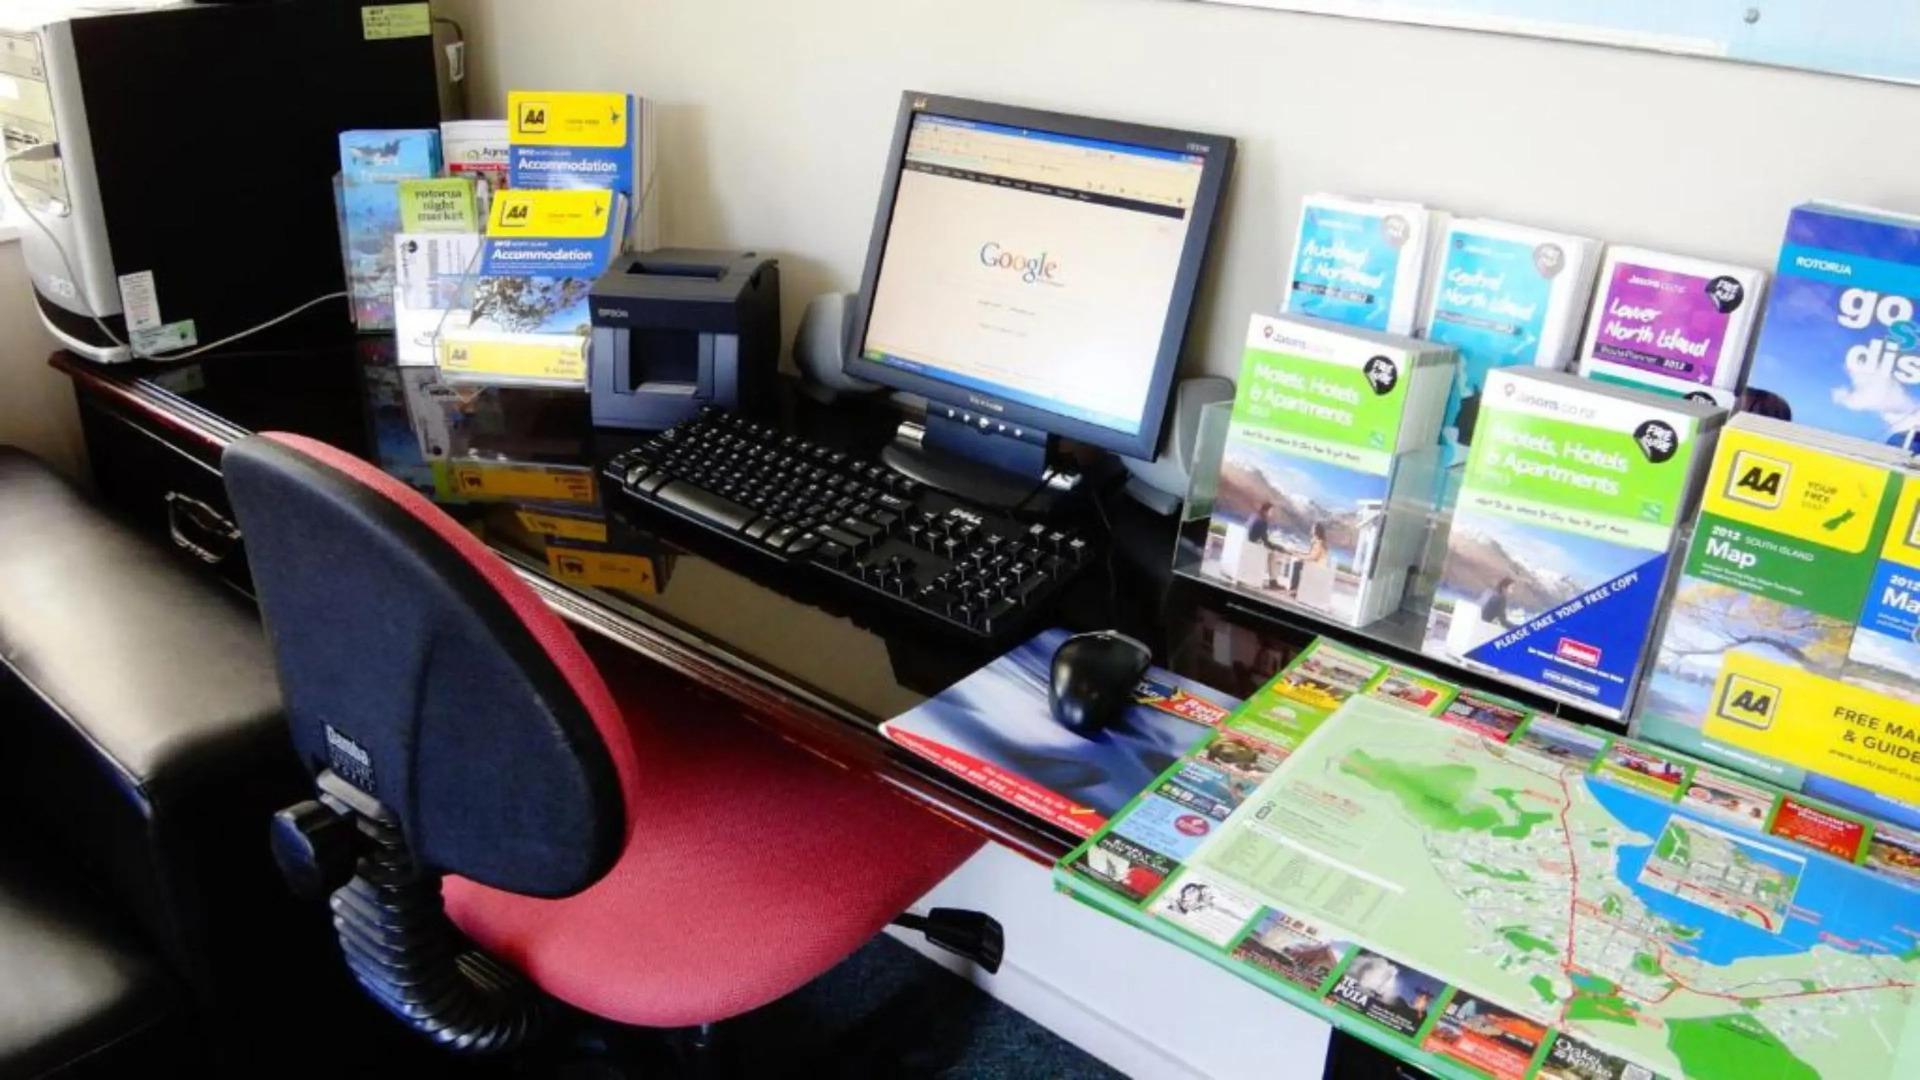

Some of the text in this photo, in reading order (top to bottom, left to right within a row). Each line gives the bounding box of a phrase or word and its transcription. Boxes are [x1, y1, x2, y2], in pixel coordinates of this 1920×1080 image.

[524, 109, 545, 125] AA
[518, 157, 618, 173] Accommodation
[414, 188, 462, 199] rotorua
[417, 211, 464, 222] market
[422, 199, 455, 212] night
[505, 205, 528, 220] AA
[491, 248, 594, 261] Accommodation
[980, 241, 1058, 284] Google
[1795, 256, 1852, 276] ROTORUA
[1609, 297, 1663, 321] Lower
[1837, 288, 1914, 329] go
[1604, 320, 1711, 358] North Island
[1646, 424, 1673, 442] FREE
[1563, 441, 1629, 474] Hotels
[1503, 451, 1620, 496] Apartments
[1736, 466, 1782, 496] AA
[1803, 490, 1831, 504] FREE
[1705, 538, 1757, 569] Map
[1711, 525, 1815, 562] 2012 SOUTH ISLAND
[1493, 571, 1640, 651] PLEASE TAKE YOUR FREE COPY
[1183, 698, 1226, 719] Rent
[1731, 690, 1771, 716] AA
[1833, 706, 1881, 731] FREE
[1842, 729, 1857, 744] &
[1340, 974, 1357, 989] TE
[1333, 982, 1369, 1006] PUIA
